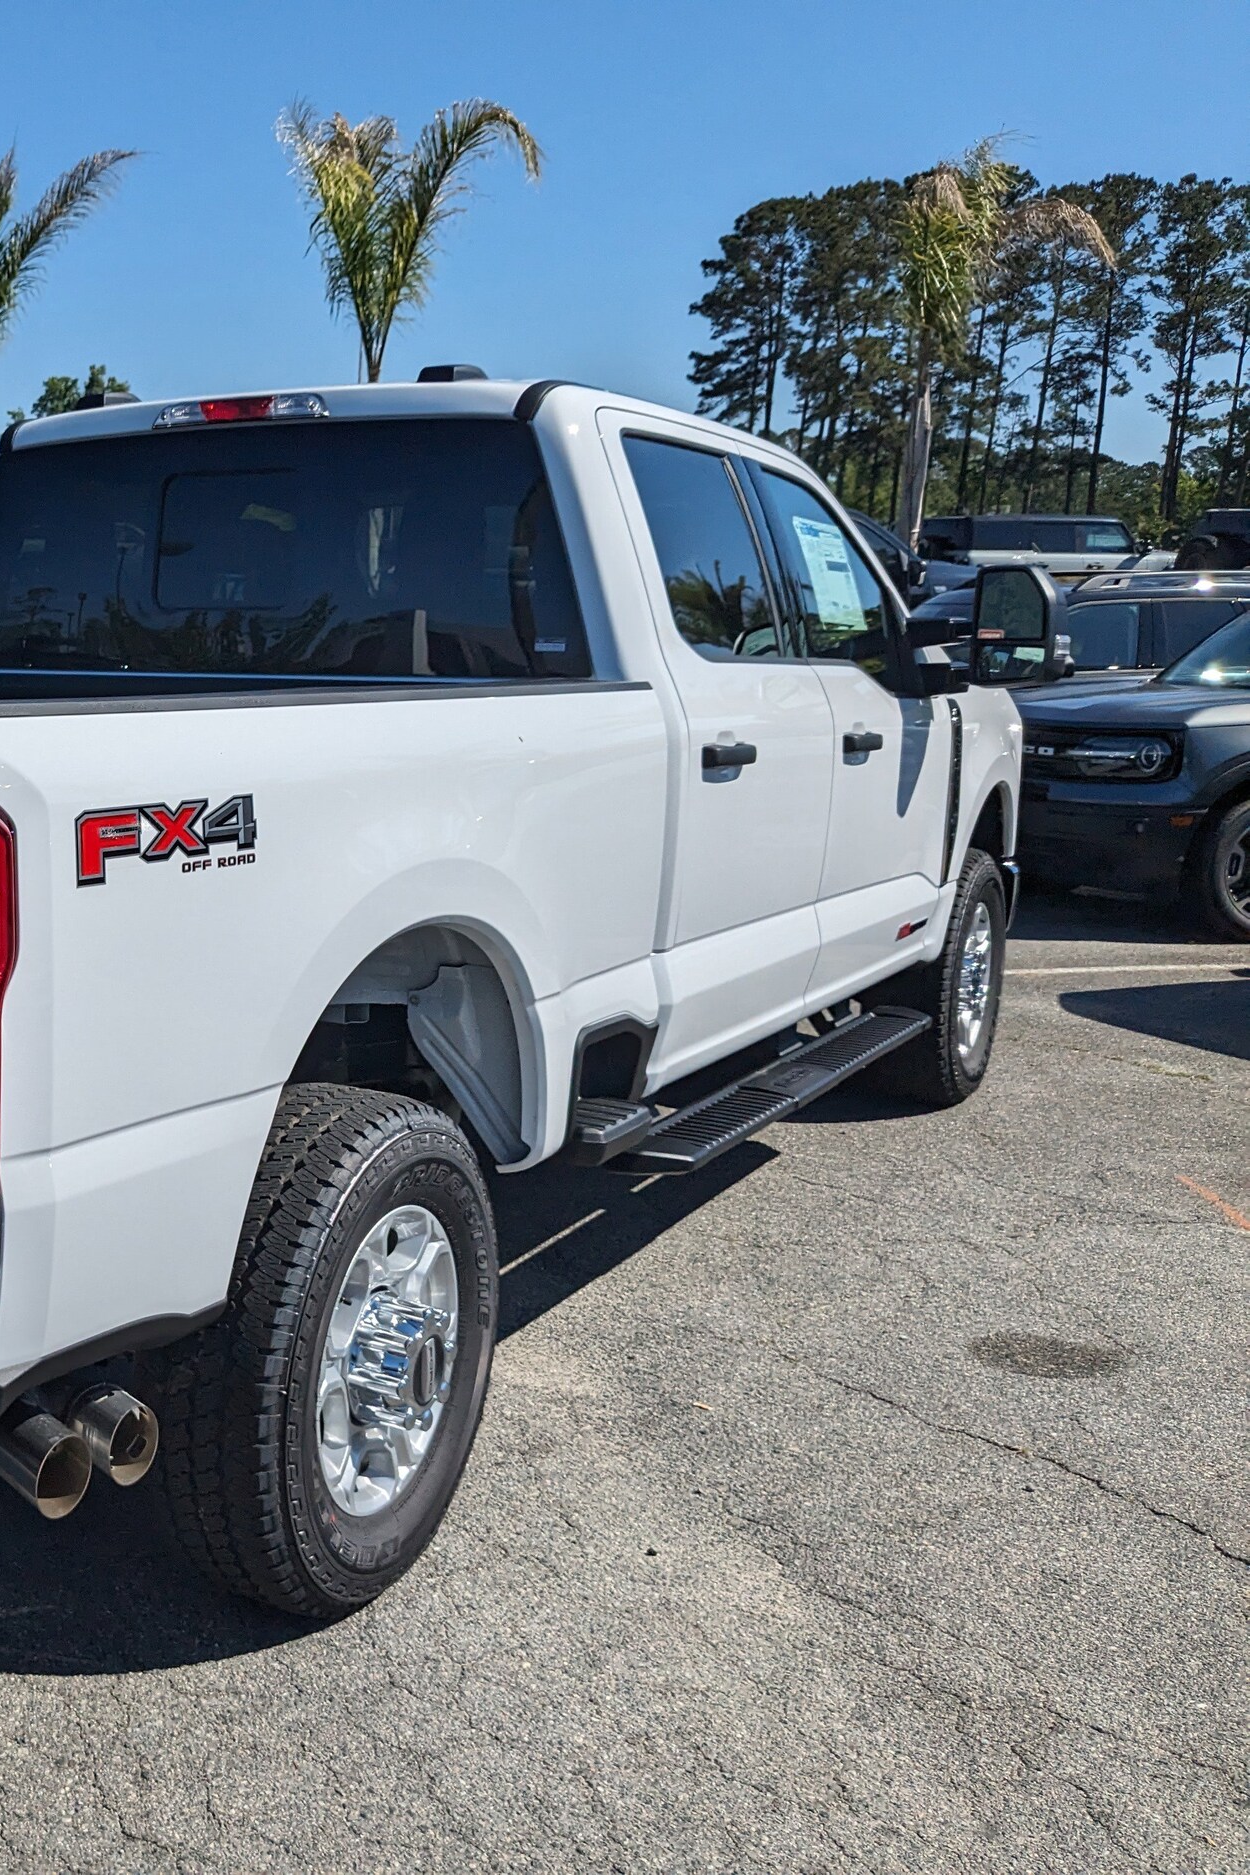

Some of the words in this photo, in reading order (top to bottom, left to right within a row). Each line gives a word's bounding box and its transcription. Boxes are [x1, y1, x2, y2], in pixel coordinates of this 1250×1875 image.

[75, 793, 257, 888] FX4
[182, 859, 212, 874] OFF
[217, 853, 256, 868] ROAD
[391, 1162, 491, 1331] BRIDGESTONE
